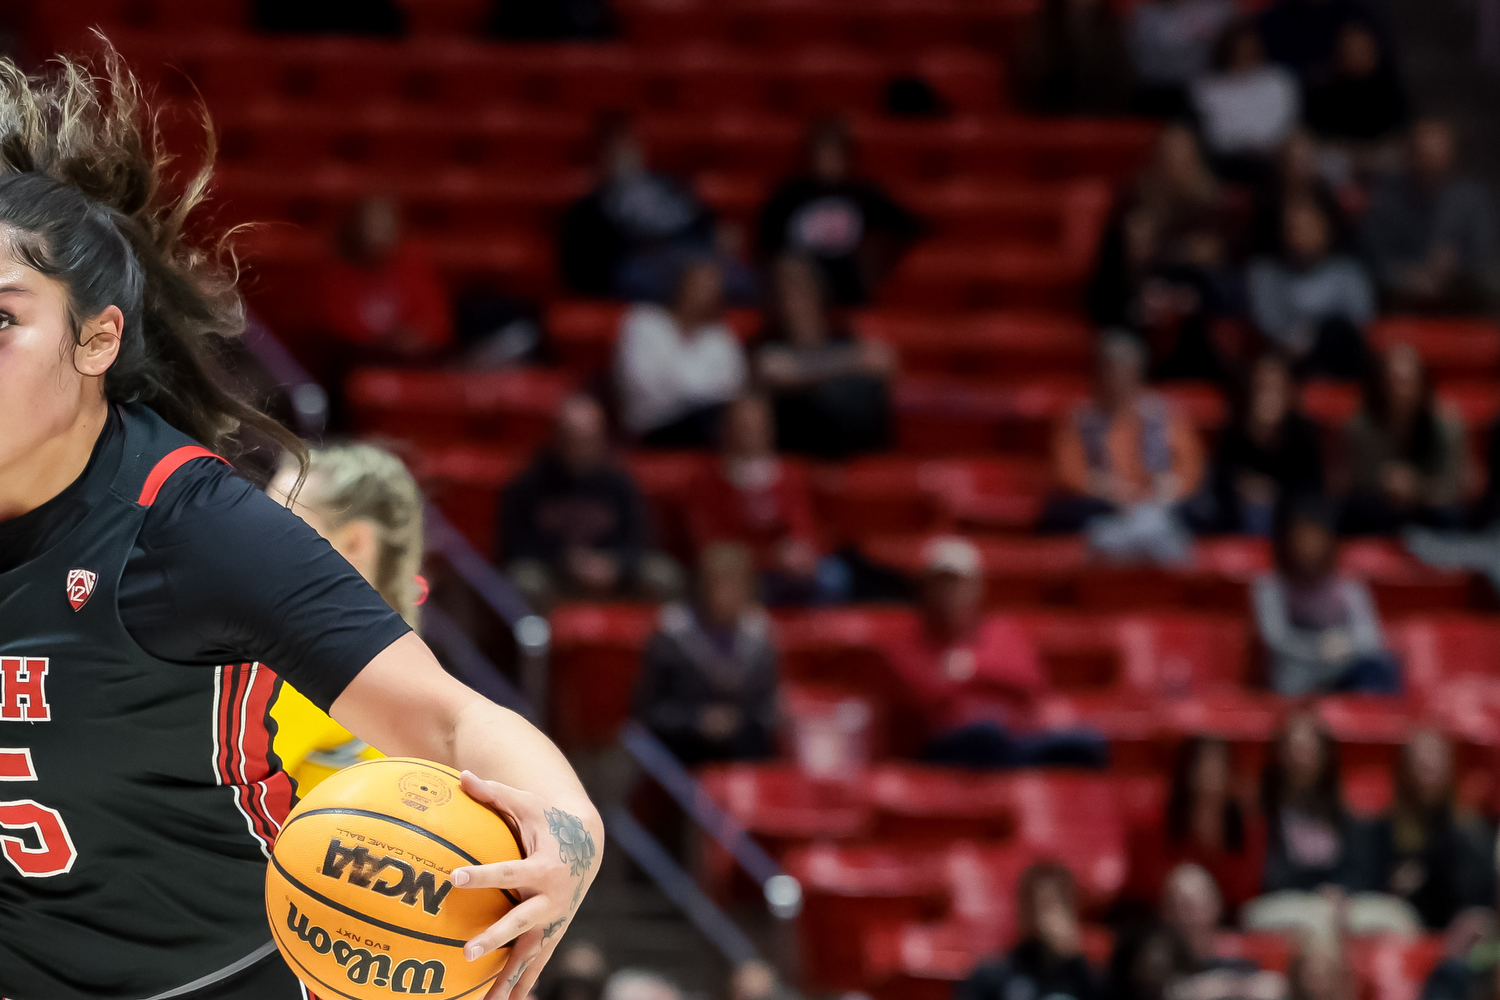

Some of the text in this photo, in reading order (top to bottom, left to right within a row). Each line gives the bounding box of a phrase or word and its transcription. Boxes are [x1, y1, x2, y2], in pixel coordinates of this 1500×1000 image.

[66, 569, 96, 595] PAC
[70, 586, 86, 602] 12
[336, 827, 452, 876] FFICIAL GAME BALL
[320, 837, 454, 917] NCAA
[285, 900, 447, 995] Wilson
[336, 927, 391, 952] EVO NXT
